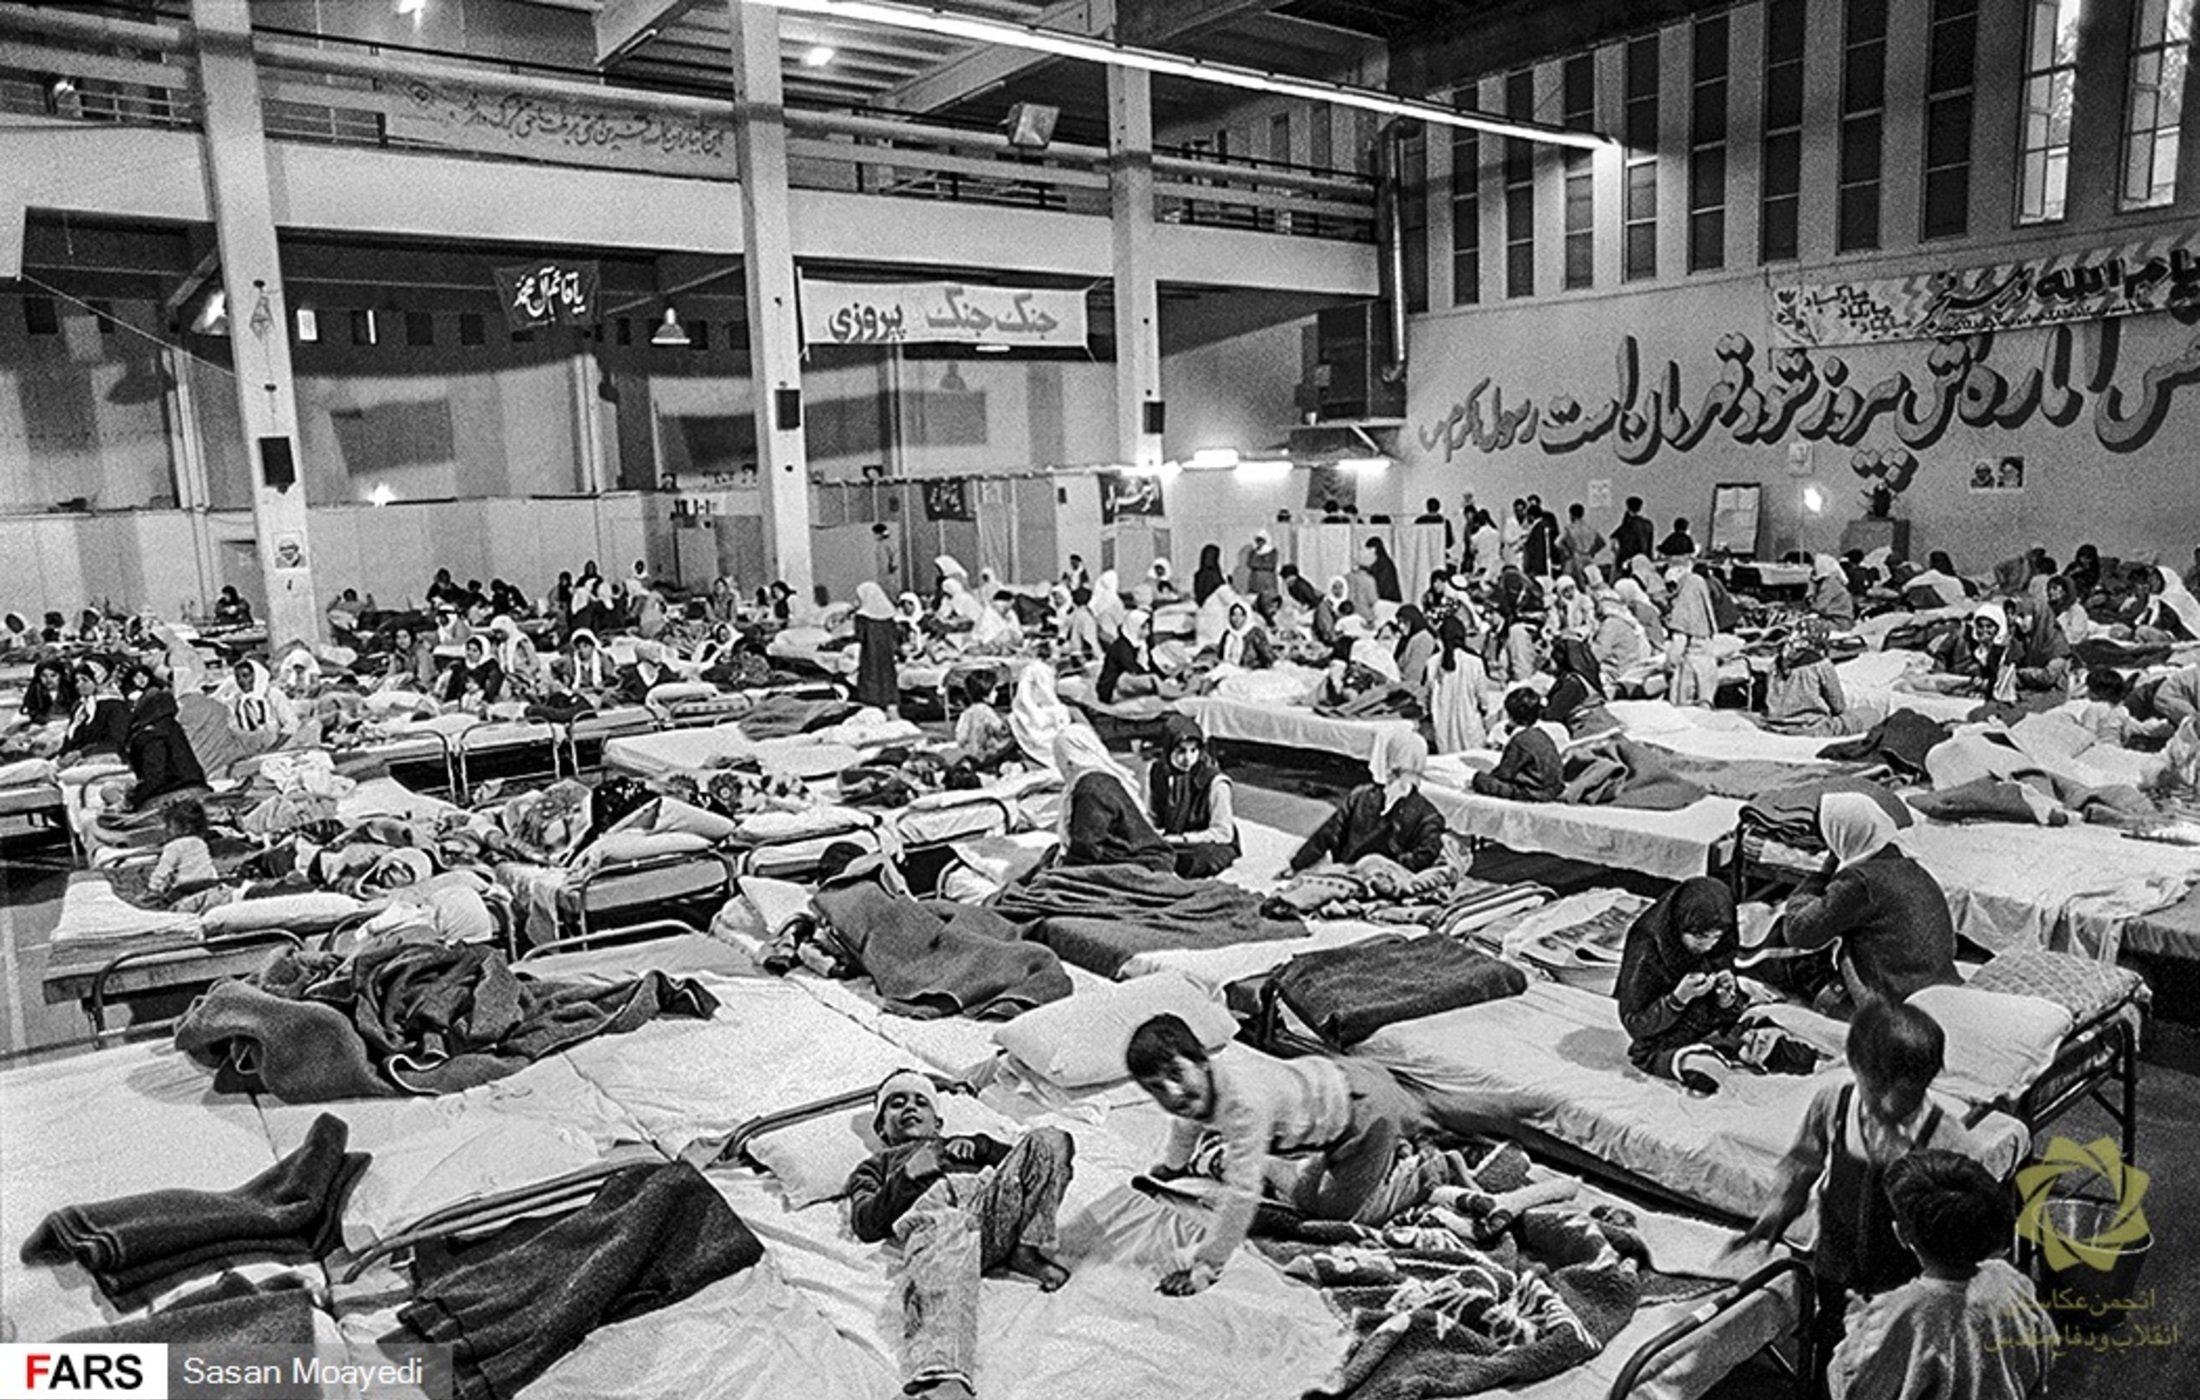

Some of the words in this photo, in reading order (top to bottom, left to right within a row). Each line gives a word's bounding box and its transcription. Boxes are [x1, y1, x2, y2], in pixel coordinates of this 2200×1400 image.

[829, 302, 907, 343] پیروزی
[926, 286, 993, 338] جنگ
[995, 292, 1058, 340] جنگ
[1540, 334, 1640, 456] است
